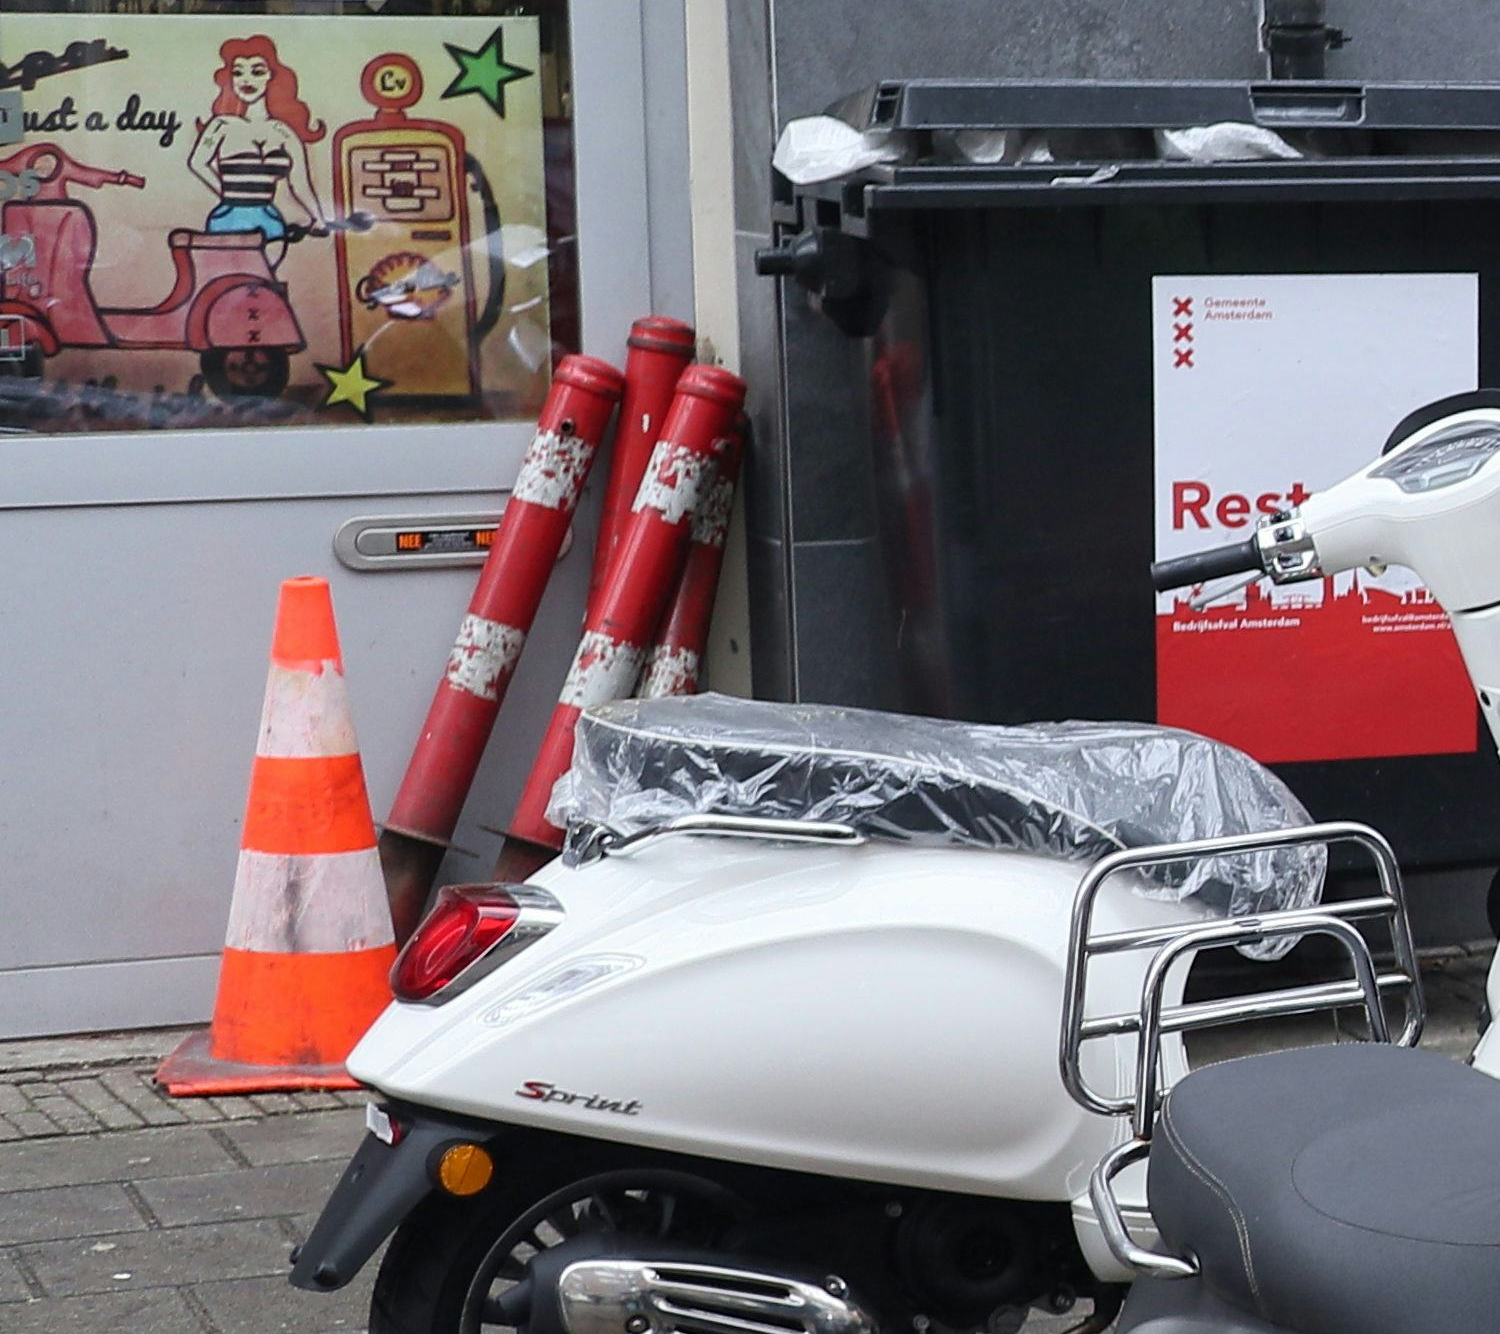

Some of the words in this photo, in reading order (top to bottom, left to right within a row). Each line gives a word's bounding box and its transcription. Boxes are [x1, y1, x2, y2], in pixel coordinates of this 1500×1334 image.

[22, 95, 79, 133] ust
[85, 110, 110, 132] a
[116, 94, 182, 148] day
[1204, 297, 1266, 309] Gemeente
[1204, 309, 1274, 322] Amsterdam
[1240, 616, 1301, 629] Amsterdam
[515, 1081, 644, 1115] Sprint
